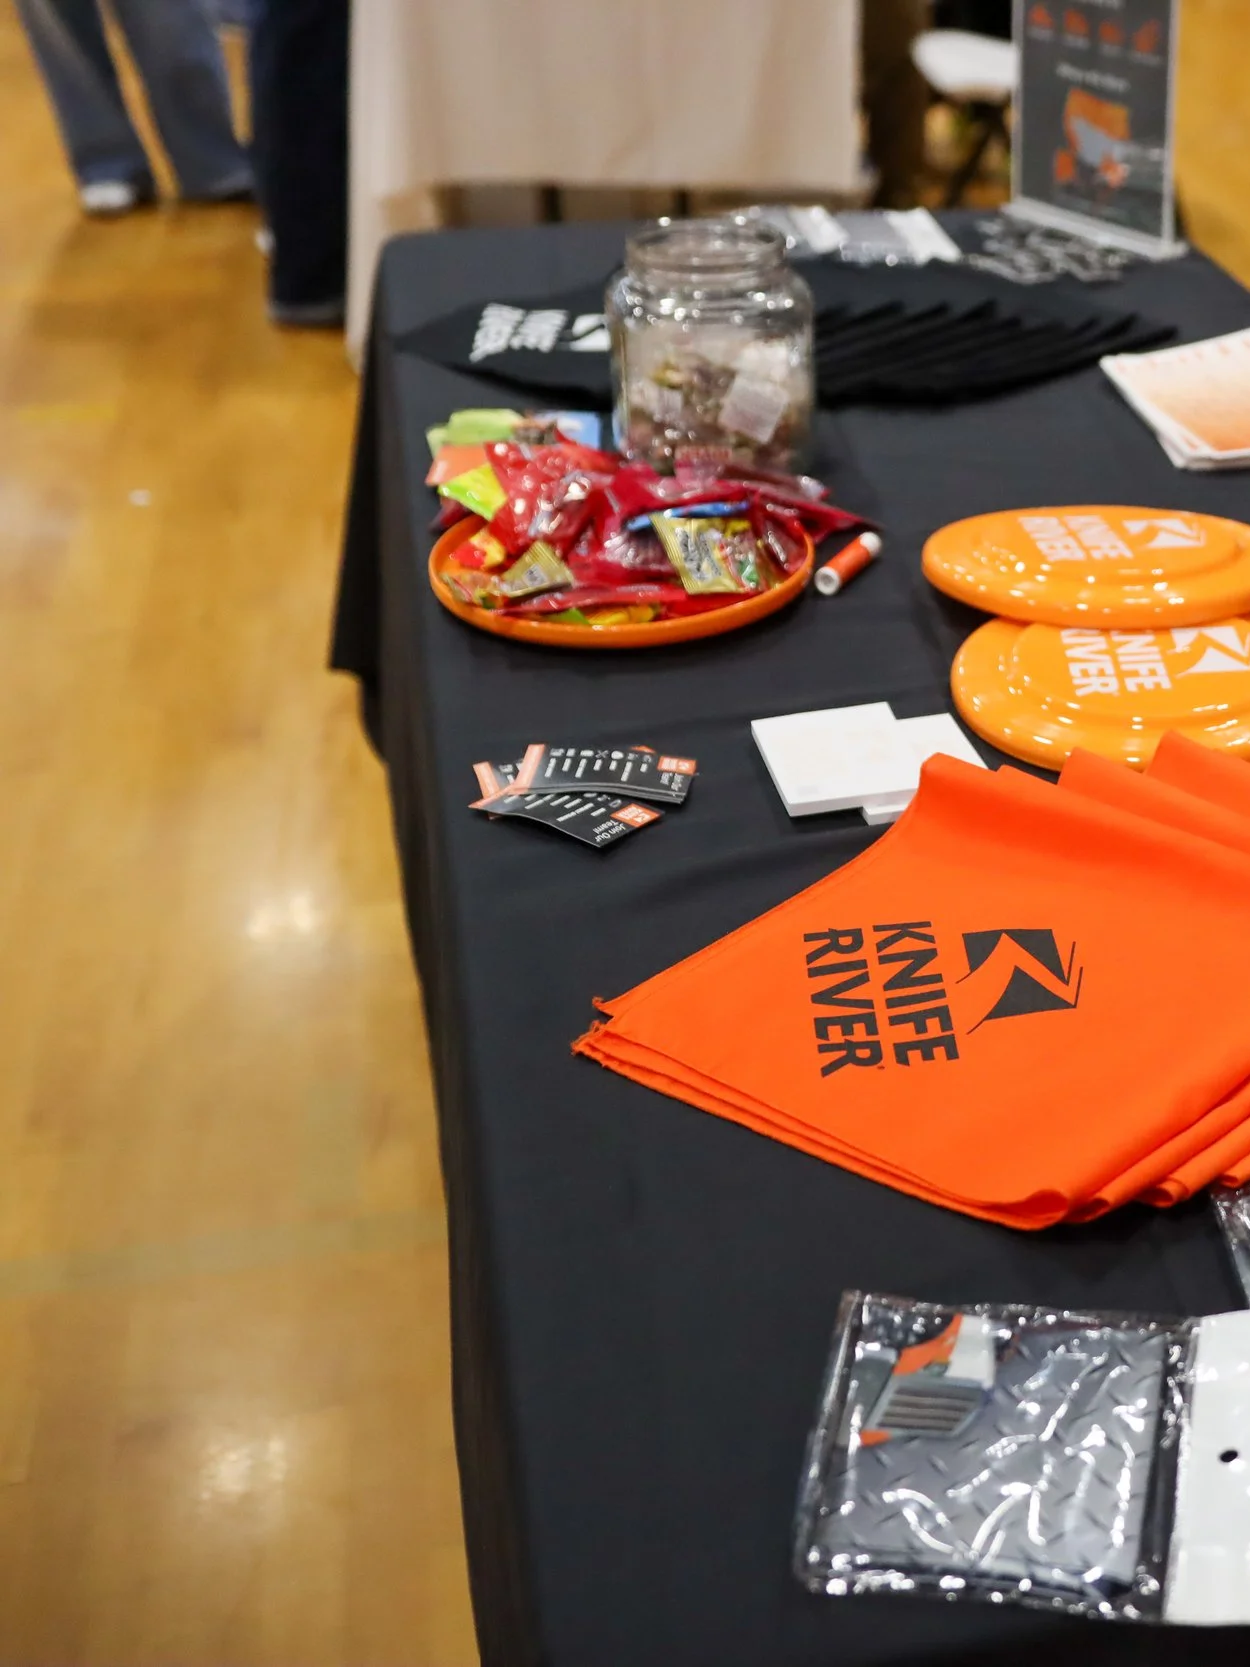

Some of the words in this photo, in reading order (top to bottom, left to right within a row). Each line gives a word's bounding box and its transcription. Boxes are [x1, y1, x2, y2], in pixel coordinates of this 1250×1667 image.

[1017, 516, 1087, 562] RIVER
[1063, 514, 1135, 560] KNIFE
[1109, 629, 1173, 693] NIFE
[803, 927, 884, 1079] RIVER
[872, 920, 960, 1067] KNIFE
